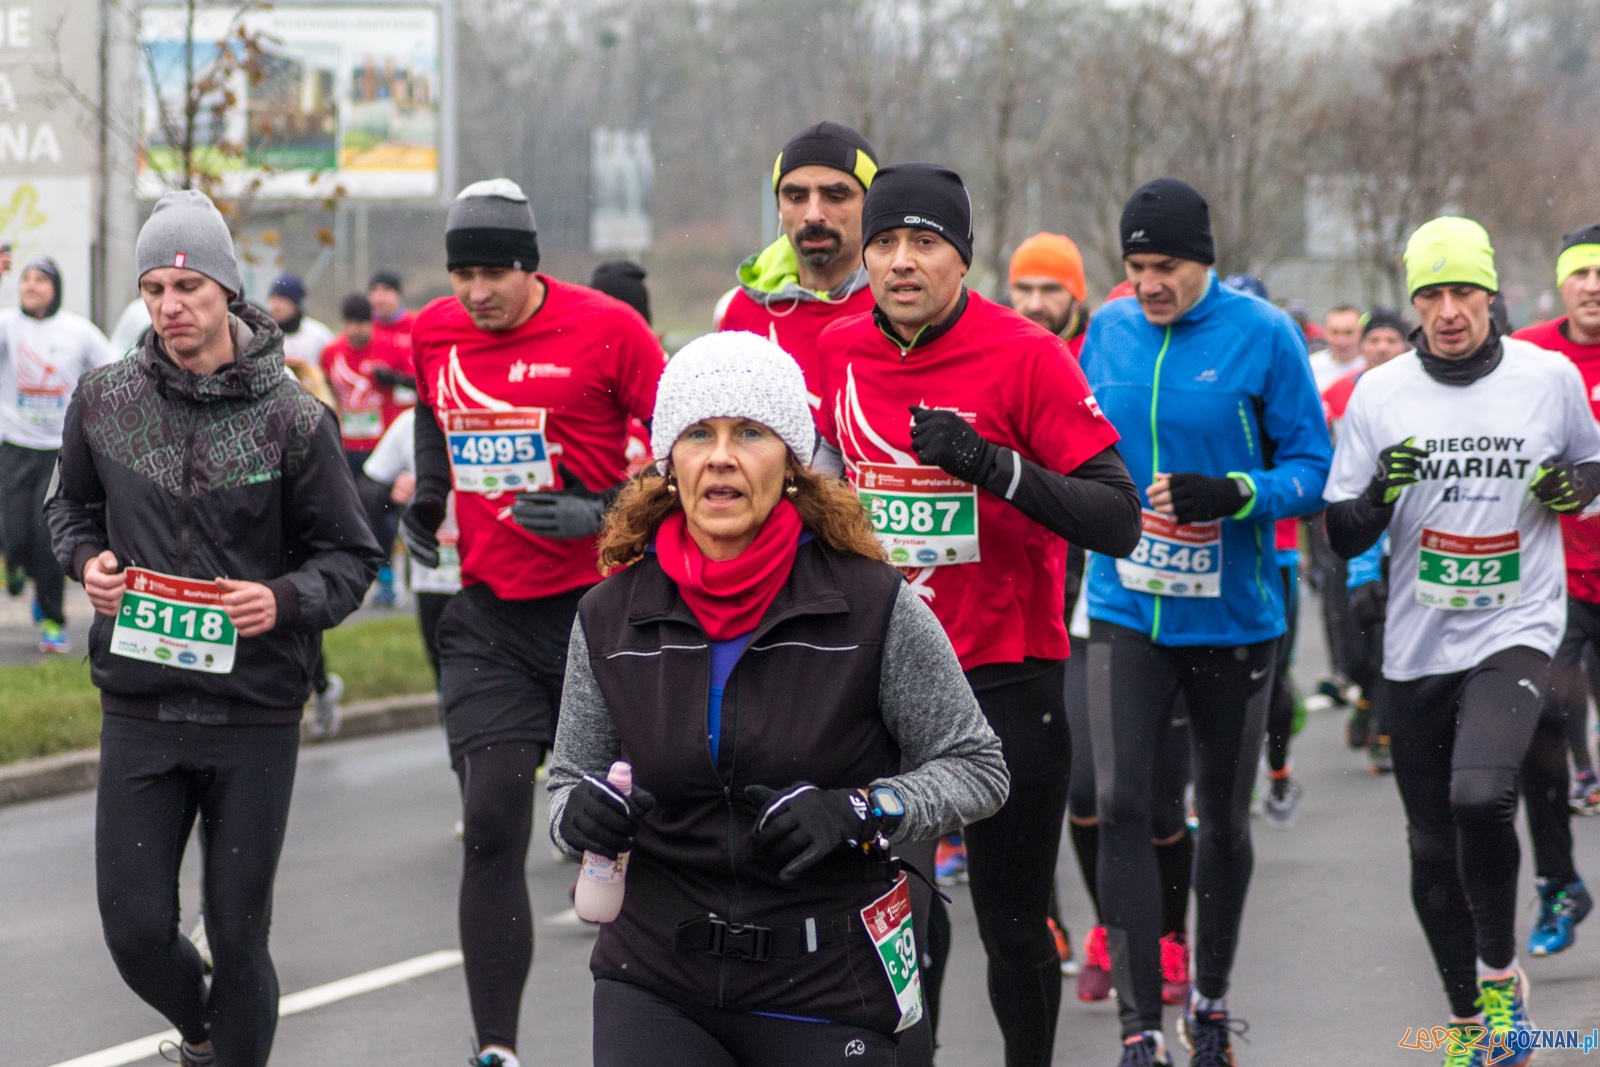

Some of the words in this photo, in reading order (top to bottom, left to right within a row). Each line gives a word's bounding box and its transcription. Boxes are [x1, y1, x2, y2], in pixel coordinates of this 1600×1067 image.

[461, 436, 536, 464] 4995
[1425, 436, 1525, 453] BIEGOWY
[911, 477, 966, 488] RunPoland.org
[1417, 457, 1531, 481] WARIAT
[871, 498, 960, 533] 5987
[893, 537, 927, 547] Krystian
[1130, 537, 1211, 574] 8546
[1439, 558, 1503, 585] 342
[134, 600, 224, 642] 5118
